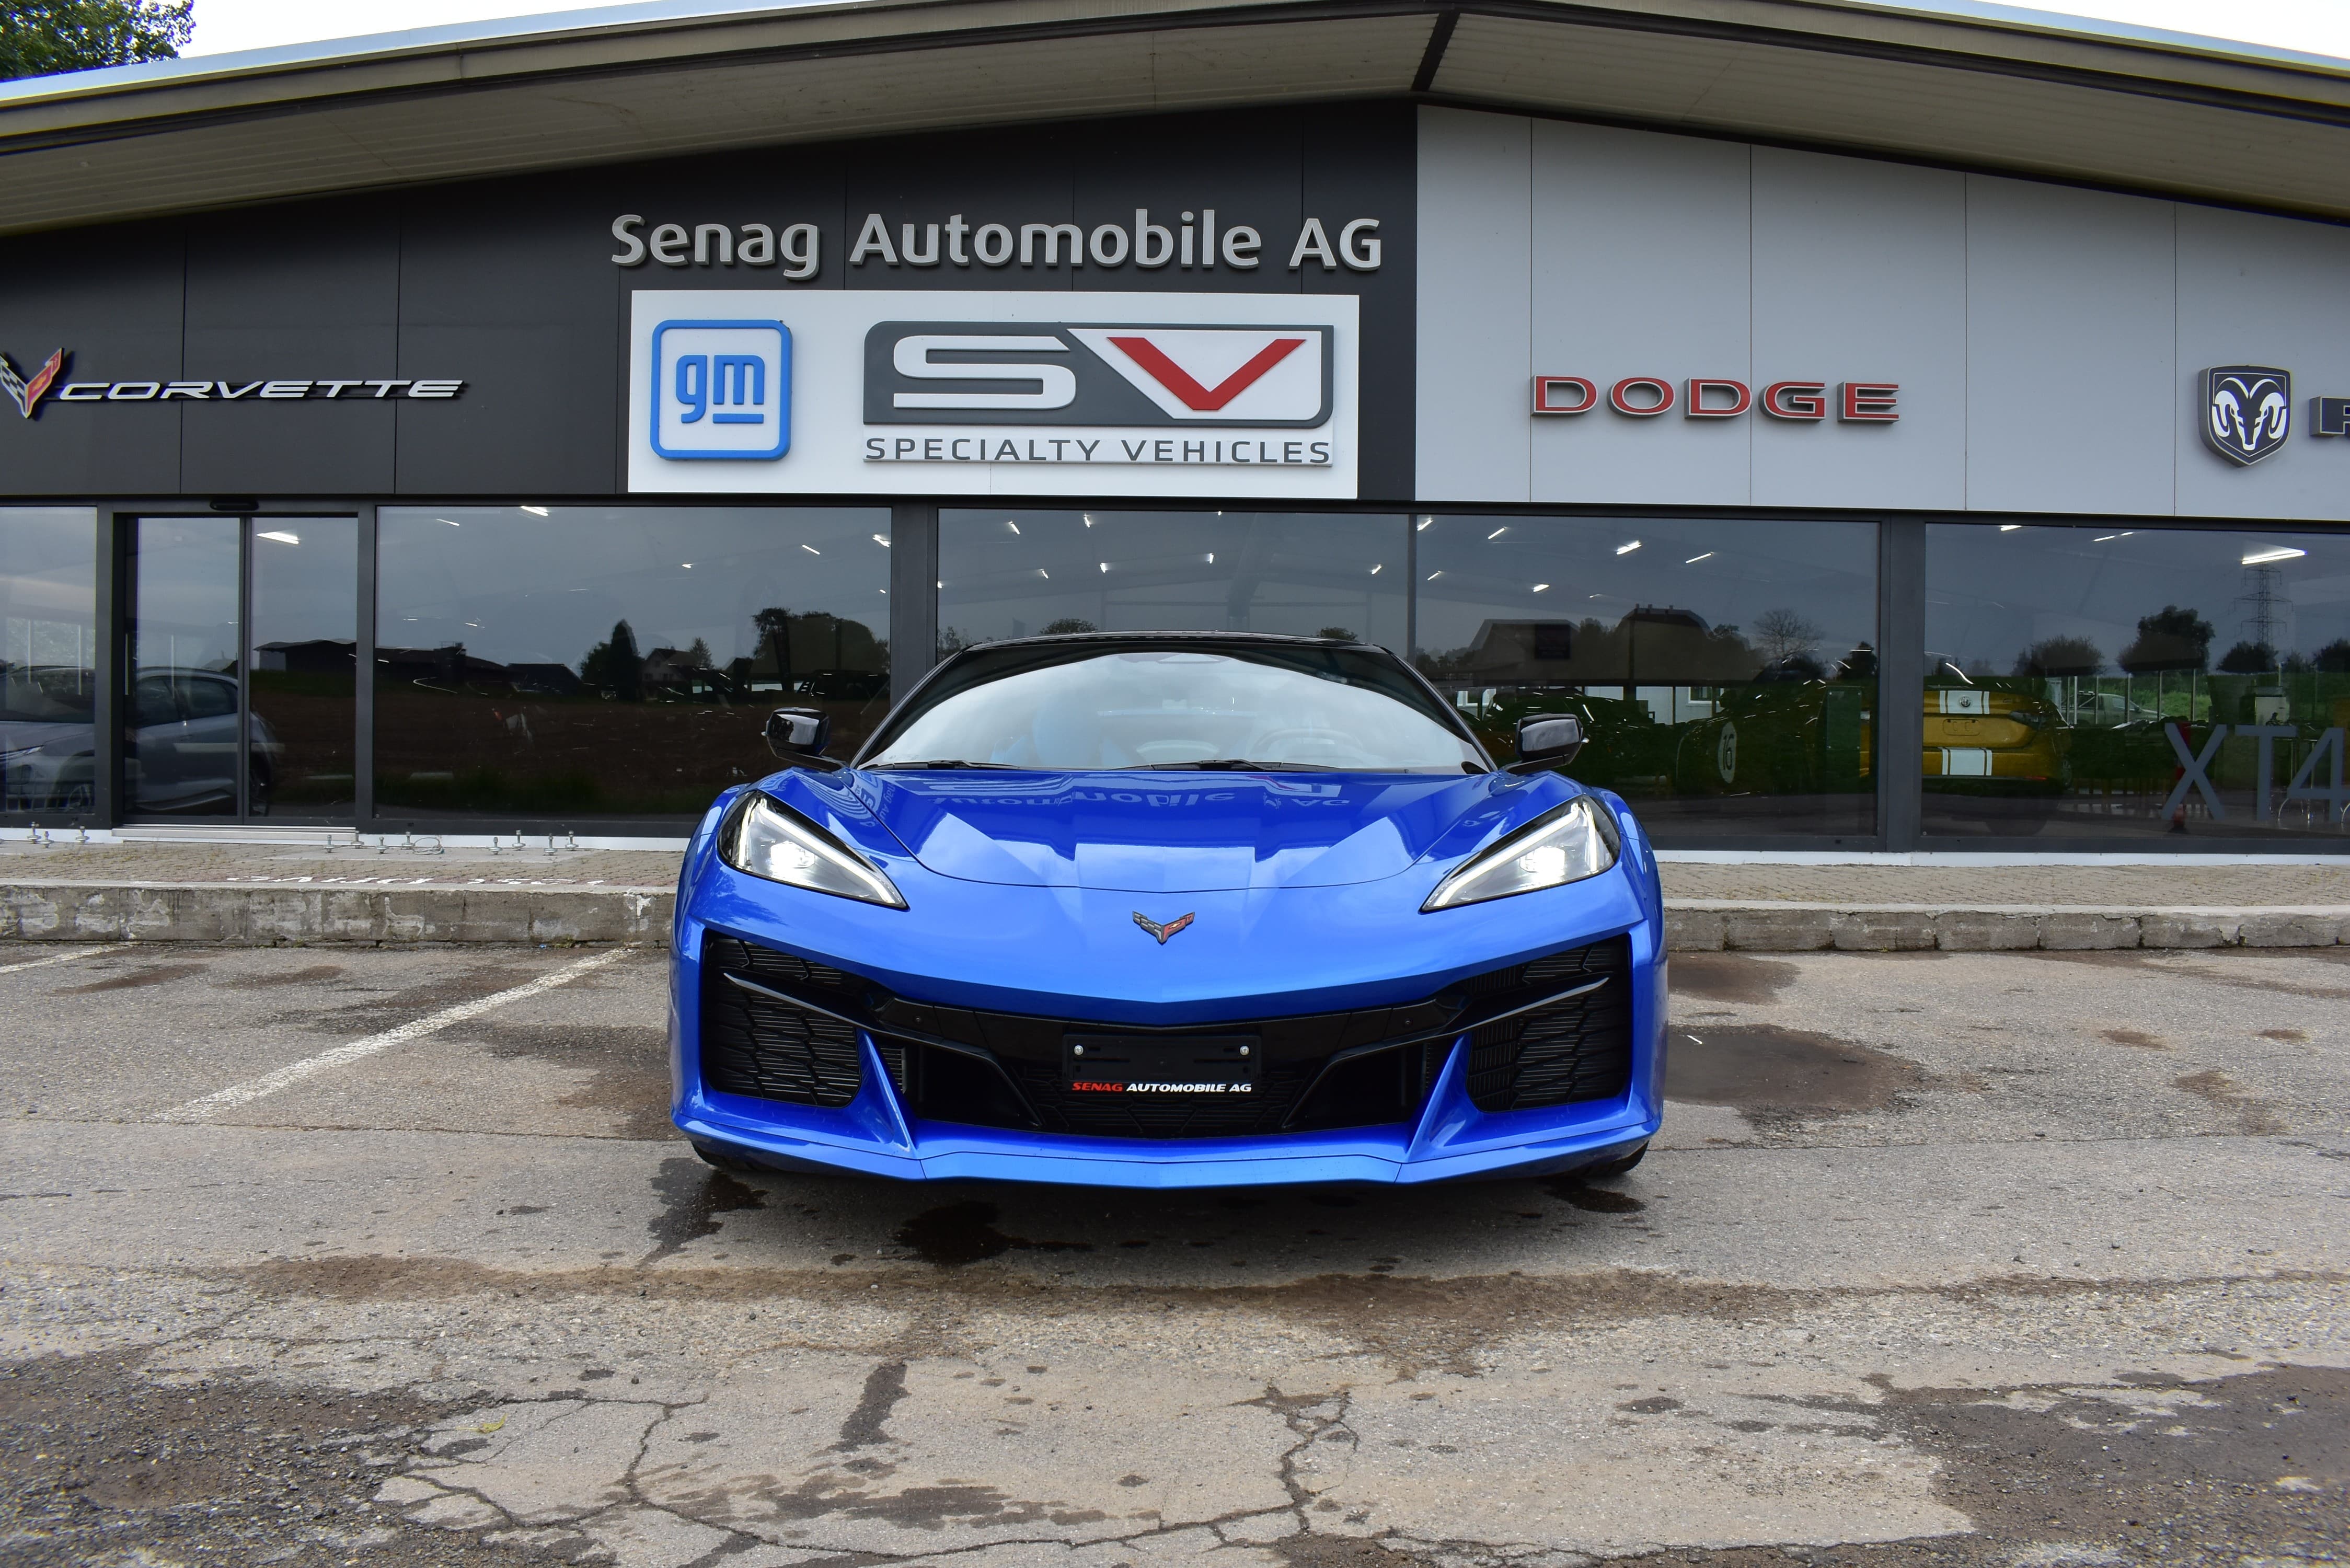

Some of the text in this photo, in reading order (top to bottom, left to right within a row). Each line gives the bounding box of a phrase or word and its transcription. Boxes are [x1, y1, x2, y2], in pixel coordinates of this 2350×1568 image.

[610, 207, 1383, 281] Senag Automobile AG
[59, 379, 464, 400] CORVETTE
[674, 353, 766, 425] gm
[892, 335, 1308, 412] SV
[1531, 375, 1899, 422] DODGE
[865, 437, 1330, 464] SPECIALTY VEHICLES
[1723, 733, 1734, 770] 16
[2160, 722, 2350, 822] XT4
[1072, 1082, 1252, 1093] SENAG AUTOMOBILE AG
